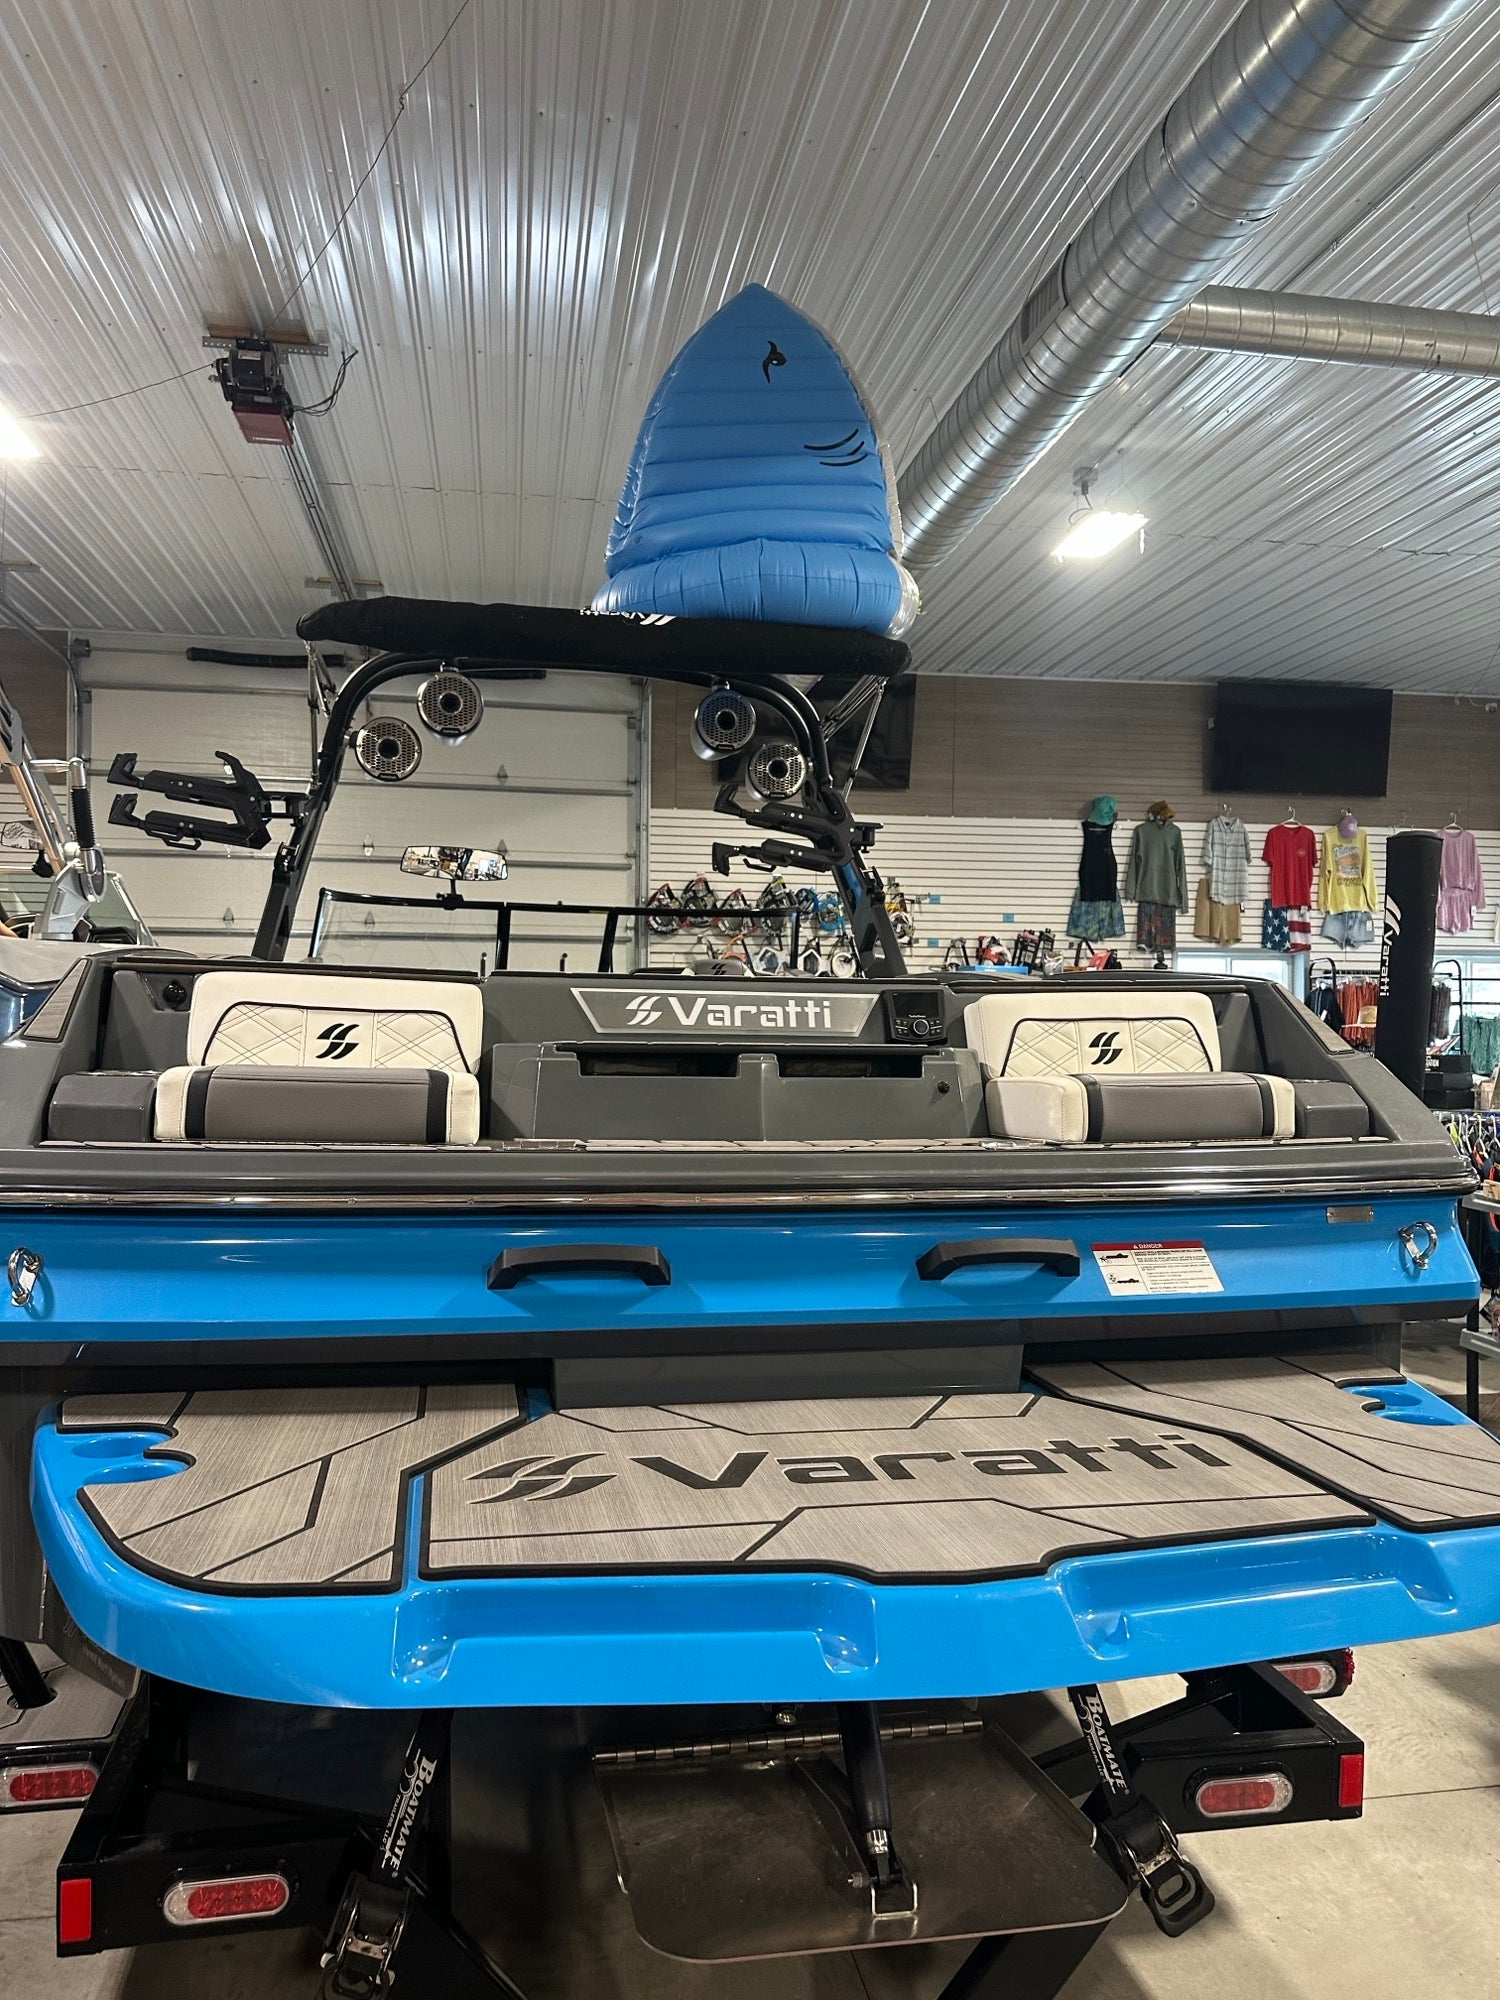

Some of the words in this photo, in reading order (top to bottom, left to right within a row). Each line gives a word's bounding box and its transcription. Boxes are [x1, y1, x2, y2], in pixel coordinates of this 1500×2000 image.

[1379, 930, 1393, 997] Varatti
[667, 995, 832, 1029] Varatti
[629, 1433, 1231, 1490] Varatti
[1086, 1692, 1127, 1789] BOATMATE
[390, 1756, 437, 1871] BOATMATE
